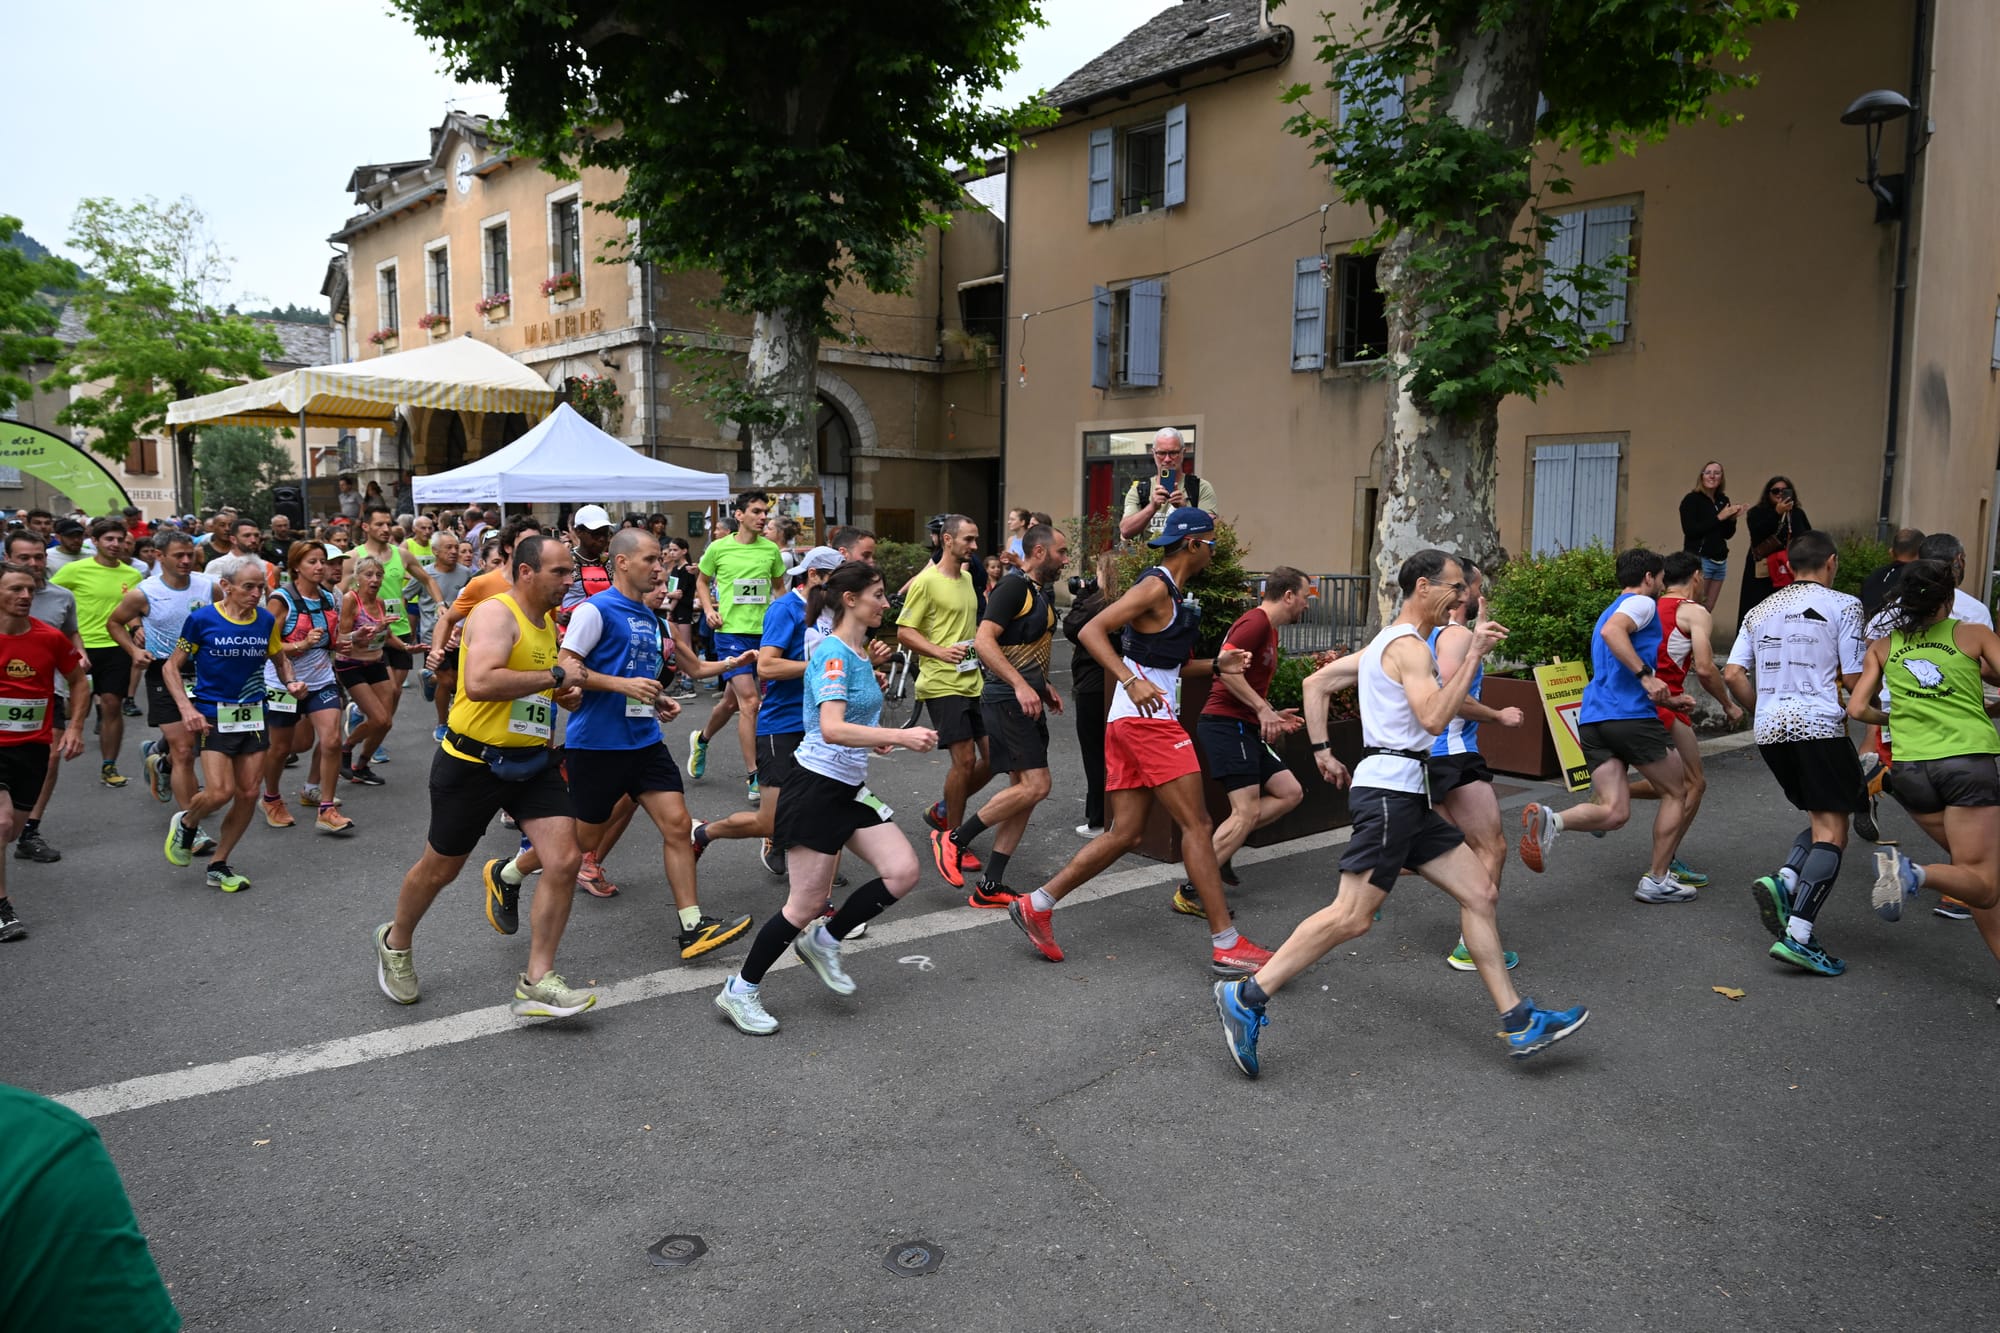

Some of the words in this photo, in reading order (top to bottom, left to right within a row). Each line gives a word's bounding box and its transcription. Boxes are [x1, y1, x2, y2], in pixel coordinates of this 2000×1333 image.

[523, 308, 602, 345] MAIRIE
[11, 436, 36, 445] des
[742, 585, 757, 596] 21
[214, 636, 269, 646] MACADAM
[268, 690, 287, 702] 27
[8, 707, 34, 720] 94
[232, 708, 252, 722] 18
[526, 704, 546, 723] 15
[1573, 768, 1591, 782] TION
[1221, 956, 1259, 968] SALOMON
